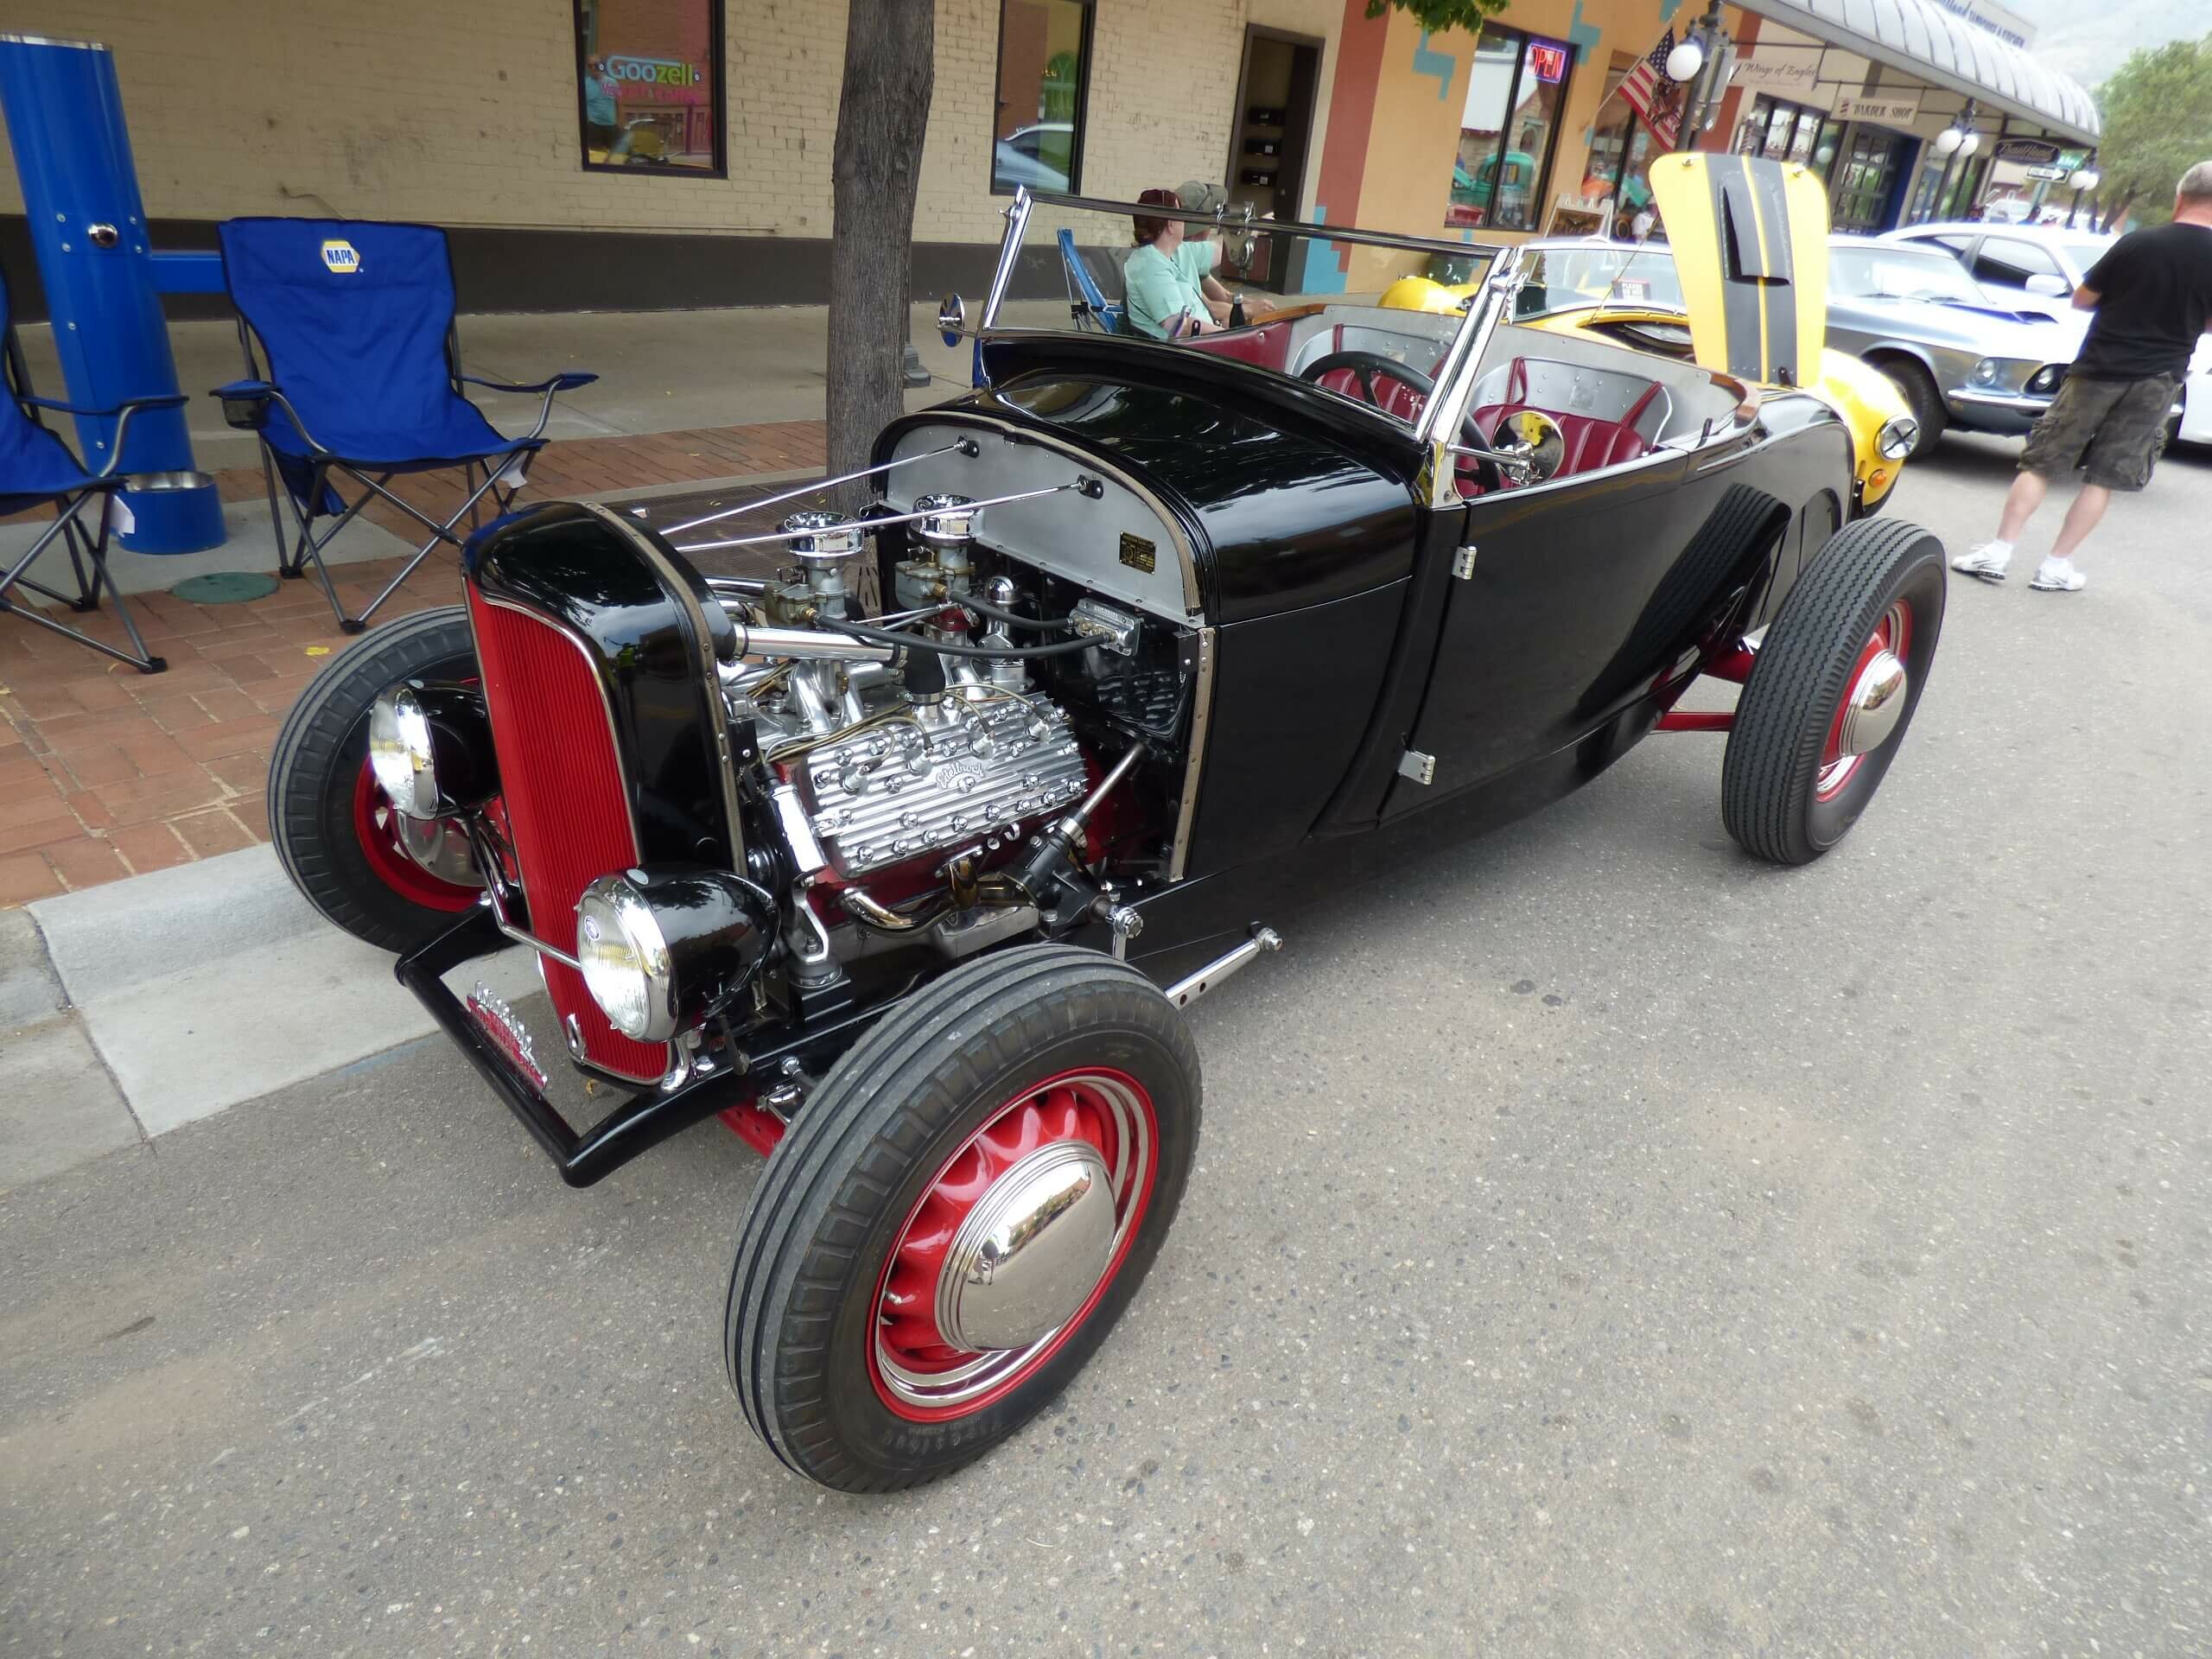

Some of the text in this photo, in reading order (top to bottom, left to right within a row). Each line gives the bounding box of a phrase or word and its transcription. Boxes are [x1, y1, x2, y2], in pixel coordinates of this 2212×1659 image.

[607, 54, 693, 86] Goozell
[1529, 46, 1562, 79] OPEN
[327, 249, 356, 264] NAPA
